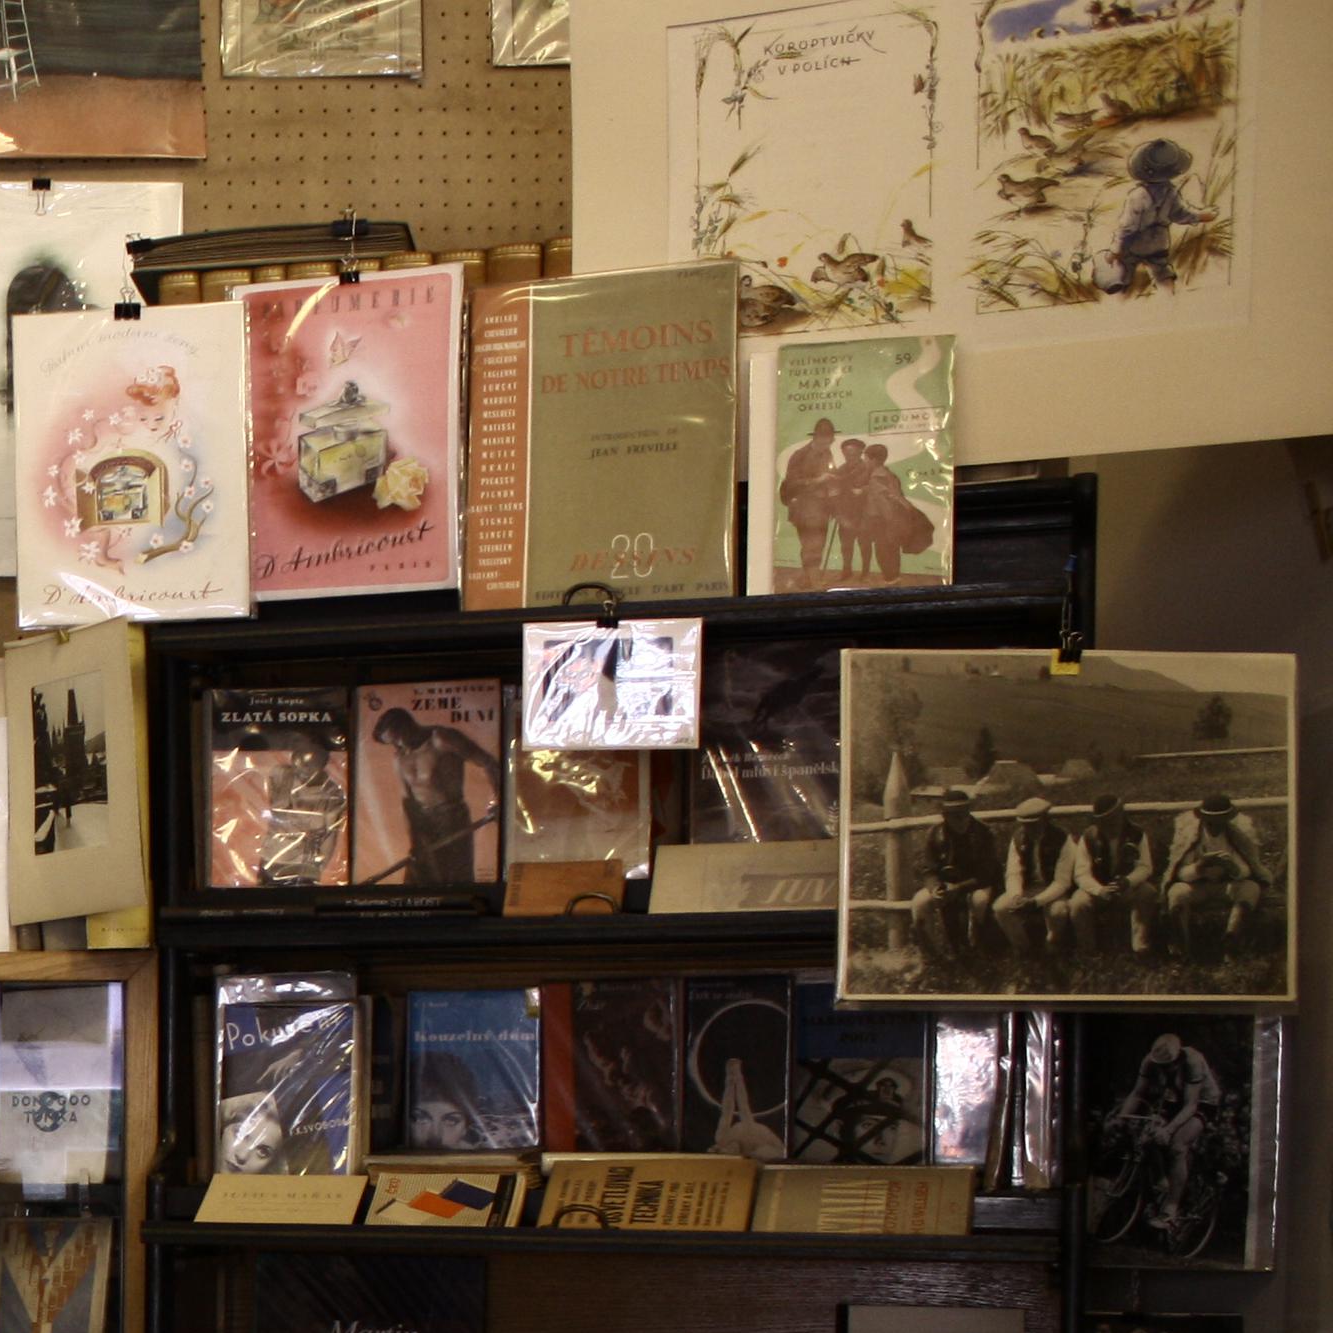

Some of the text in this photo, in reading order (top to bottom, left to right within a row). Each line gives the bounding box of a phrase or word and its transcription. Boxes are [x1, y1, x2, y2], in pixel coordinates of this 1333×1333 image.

[777, 65, 787, 76] V
[540, 373, 567, 394] DE
[221, 709, 333, 723] ZLATÁ SOPKA
